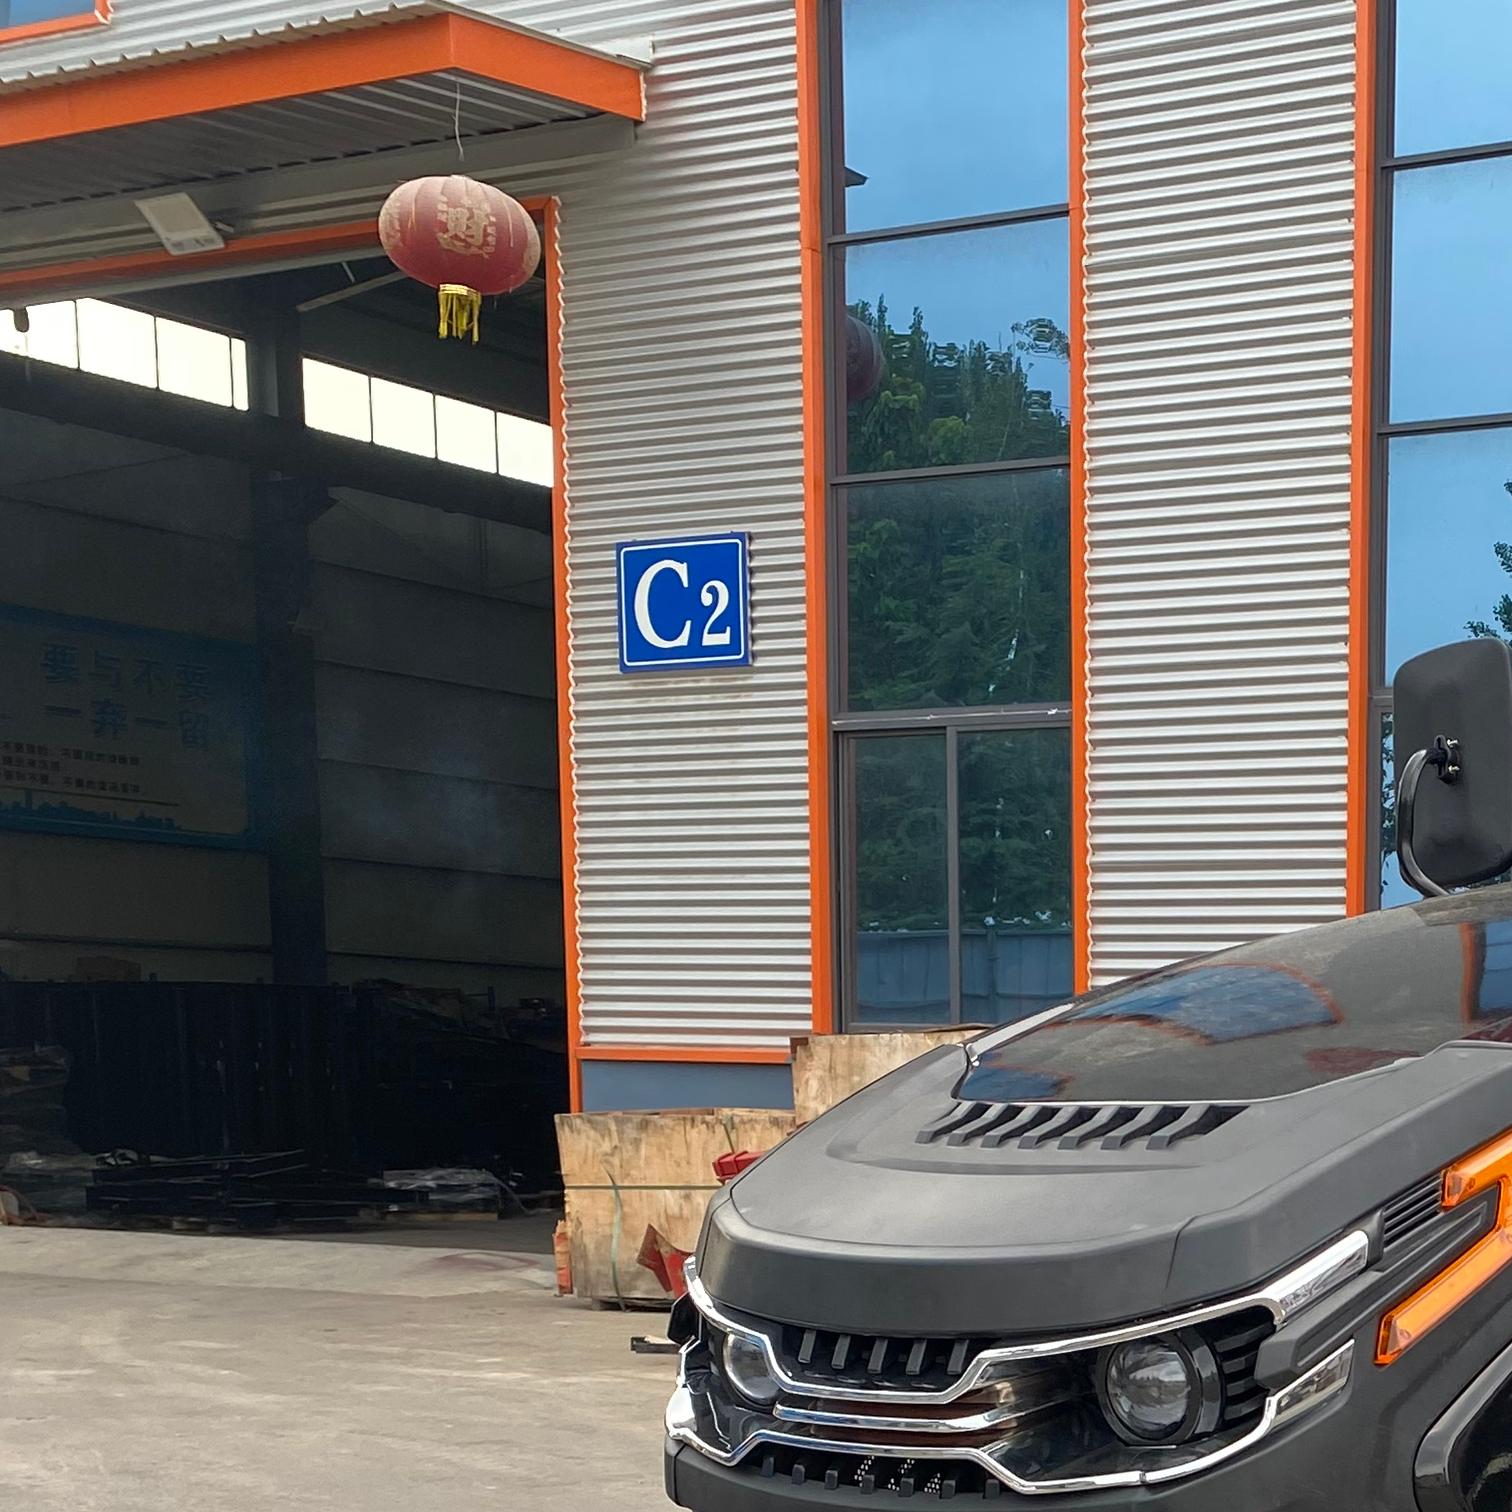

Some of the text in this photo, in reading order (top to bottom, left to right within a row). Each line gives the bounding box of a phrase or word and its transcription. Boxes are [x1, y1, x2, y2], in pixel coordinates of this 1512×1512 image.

[634, 559, 731, 649] C2
[40, 642, 212, 702] 要与不要
